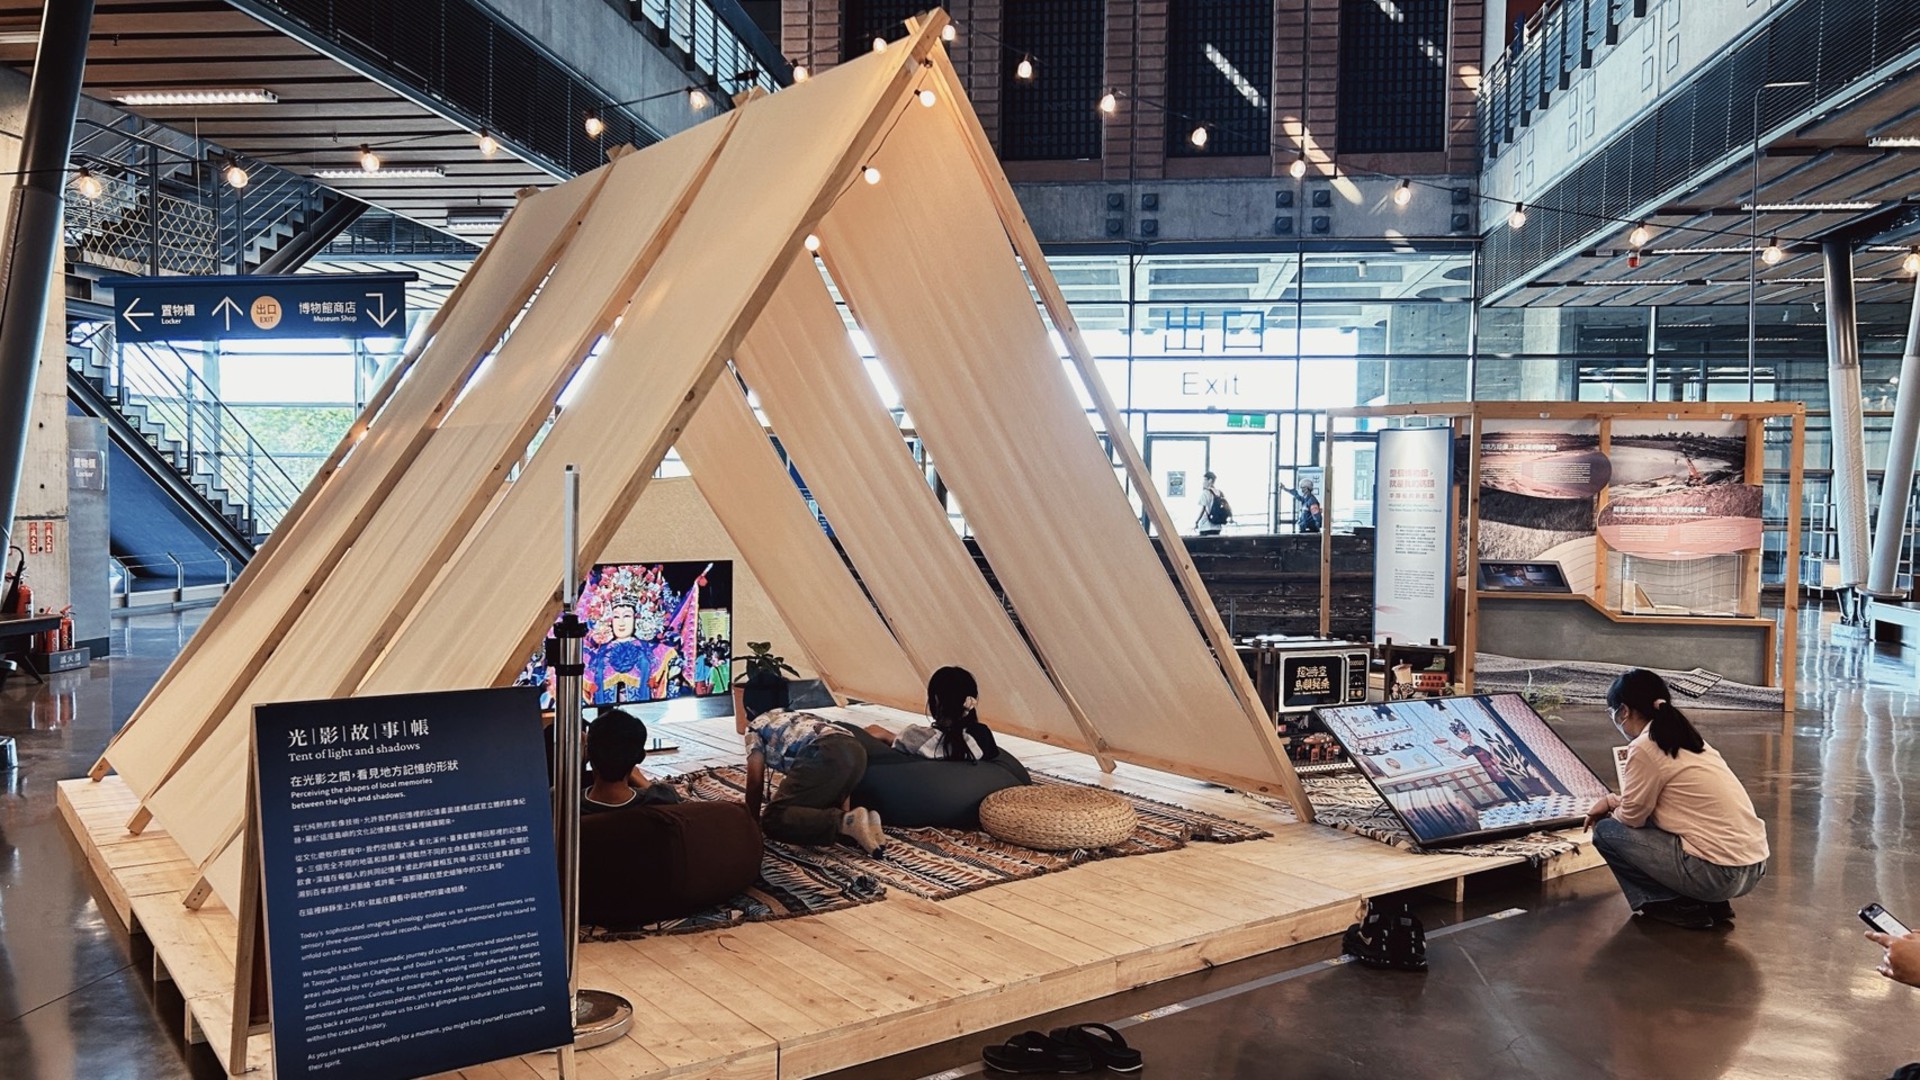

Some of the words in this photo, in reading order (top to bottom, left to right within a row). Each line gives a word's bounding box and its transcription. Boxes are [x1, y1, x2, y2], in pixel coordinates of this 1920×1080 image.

[161, 304, 196, 317] 置物櫃
[256, 304, 276, 315] 出口
[298, 302, 356, 314] 博物館商店
[341, 315, 357, 323] Shop
[1164, 307, 1264, 352] 出口
[1182, 372, 1240, 395] Exit
[287, 751, 312, 762] Tent
[314, 748, 326, 759] of
[327, 746, 352, 760] light
[353, 744, 374, 755] and
[375, 740, 420, 753] shadows
[290, 788, 330, 799] Perceiving
[344, 783, 370, 793] shapes
[378, 780, 397, 788] local
[397, 778, 432, 786] memories
[290, 799, 324, 809] between
[338, 796, 356, 805] light
[356, 794, 371, 802] and
[371, 790, 405, 800] shadows.
[299, 929, 323, 940] Today's
[366, 920, 390, 930] imaging
[391, 914, 424, 925] technology
[424, 910, 447, 919] enables
[464, 902, 495, 912] reconstruct
[496, 898, 523, 907] memories
[300, 941, 324, 950] sensory
[325, 931, 380, 945] three-dimensional
[421, 920, 446, 931] allowing
[446, 917, 468, 925] cultural
[468, 913, 495, 922] memories
[300, 951, 322, 960] unfold
[312, 965, 338, 976] brought
[379, 954, 405, 963] nomadic
[405, 950, 427, 960] journey
[456, 940, 484, 950] memories
[488, 944, 518, 955] completely
[519, 940, 539, 949] distinct
[318, 997, 342, 1007] cultural
[444, 974, 464, 984] deeply
[465, 968, 496, 979] entrenched
[497, 965, 515, 973] within
[515, 960, 541, 969] collective
[321, 984, 351, 995] inhabited
[374, 975, 400, 985] different
[400, 972, 418, 980] ethnic
[441, 964, 468, 974] revealing
[467, 960, 484, 969] vastly
[484, 956, 508, 965] different
[517, 951, 540, 960] energies
[304, 1010, 336, 1020] memories
[348, 1002, 375, 1012] resonate
[375, 999, 394, 1007] across
[426, 989, 442, 997] there
[451, 984, 466, 992] often
[466, 979, 492, 990] profound
[522, 969, 542, 980] Tracing
[305, 1023, 322, 1032] roots
[344, 1014, 368, 1025] century
[380, 1008, 397, 1017] allow
[413, 1002, 430, 1010] catch
[434, 996, 457, 1007] glimpse
[470, 990, 492, 999] cultural
[492, 986, 509, 995] truths
[508, 982, 528, 991] hidden
[351, 1039, 380, 1052] watching
[379, 1035, 400, 1045] quietly
[452, 1020, 470, 1030] might
[481, 1013, 504, 1024] yourself
[503, 1008, 534, 1020] connecting
